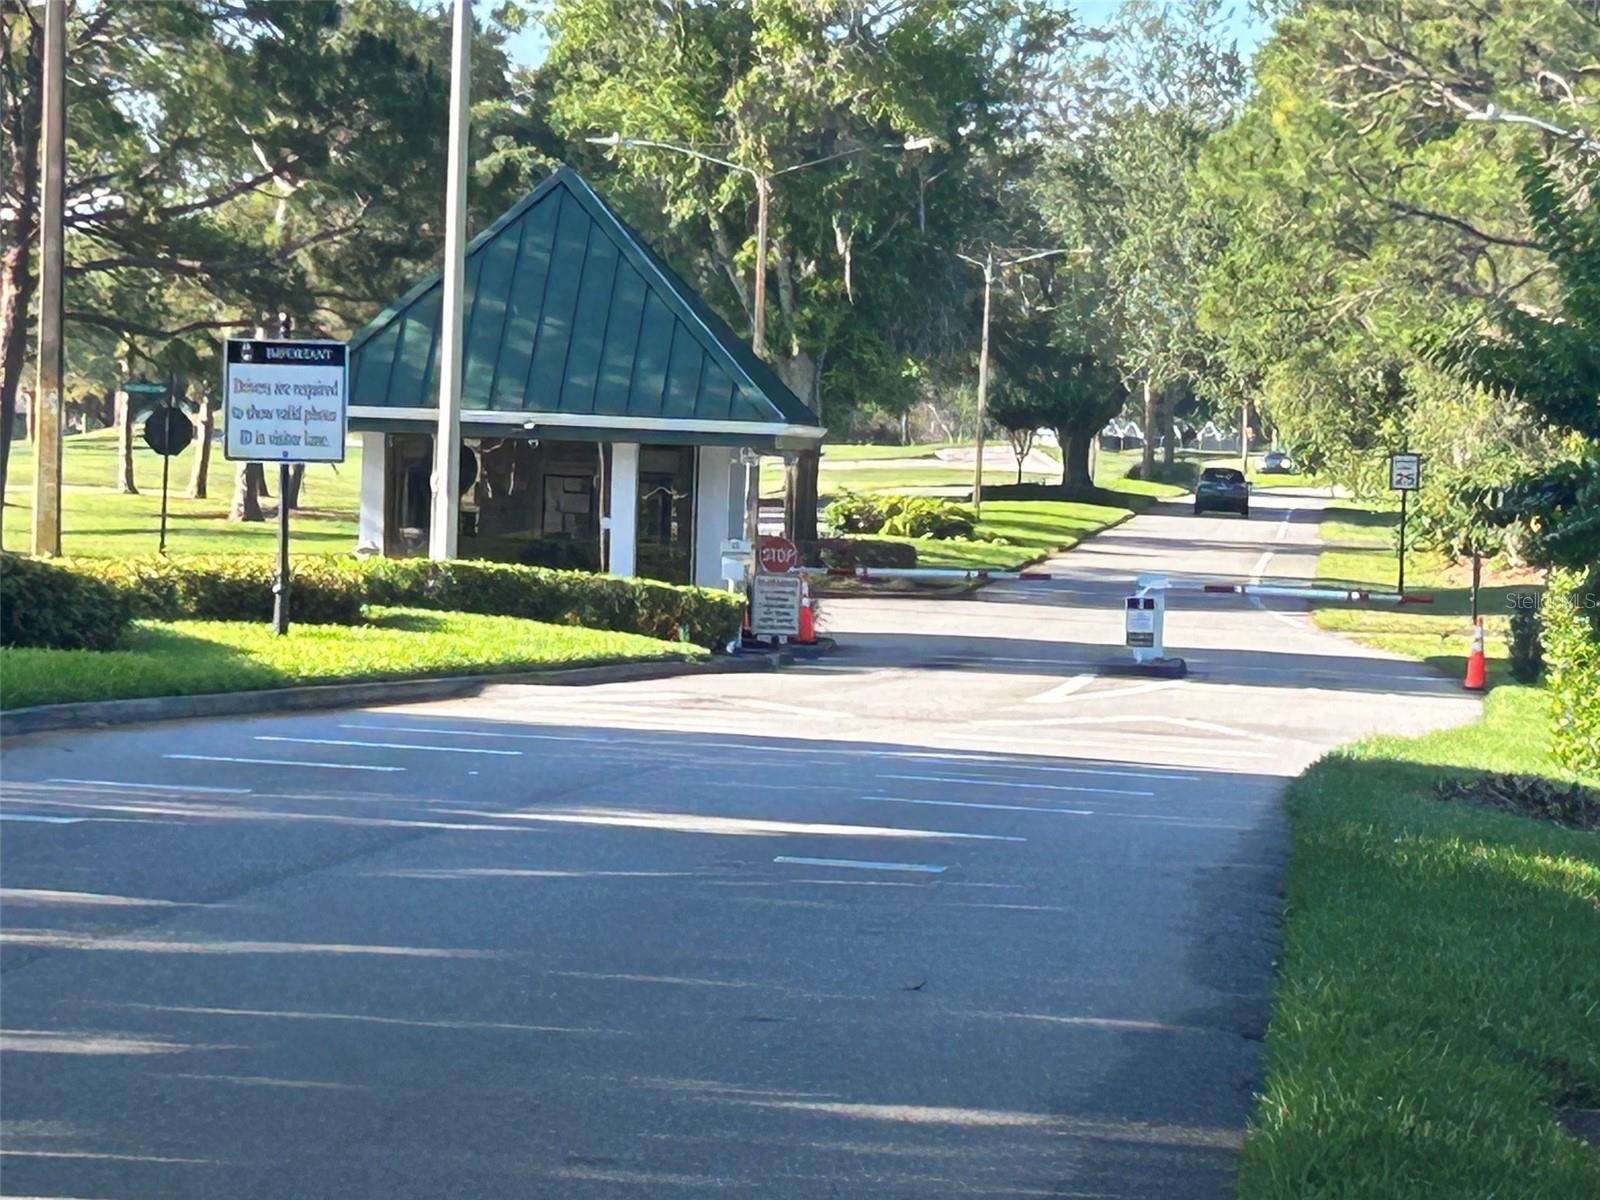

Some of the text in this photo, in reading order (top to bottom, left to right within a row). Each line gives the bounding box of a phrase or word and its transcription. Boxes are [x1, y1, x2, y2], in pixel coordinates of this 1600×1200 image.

[265, 347, 333, 360] IMPORTANT
[274, 383, 291, 396] are
[293, 380, 338, 400] required
[246, 404, 273, 421] show
[275, 405, 301, 421] valid
[255, 430, 266, 445] in
[268, 429, 301, 446] visitor
[1395, 473, 1415, 486] 25
[761, 547, 794, 563] STOP
